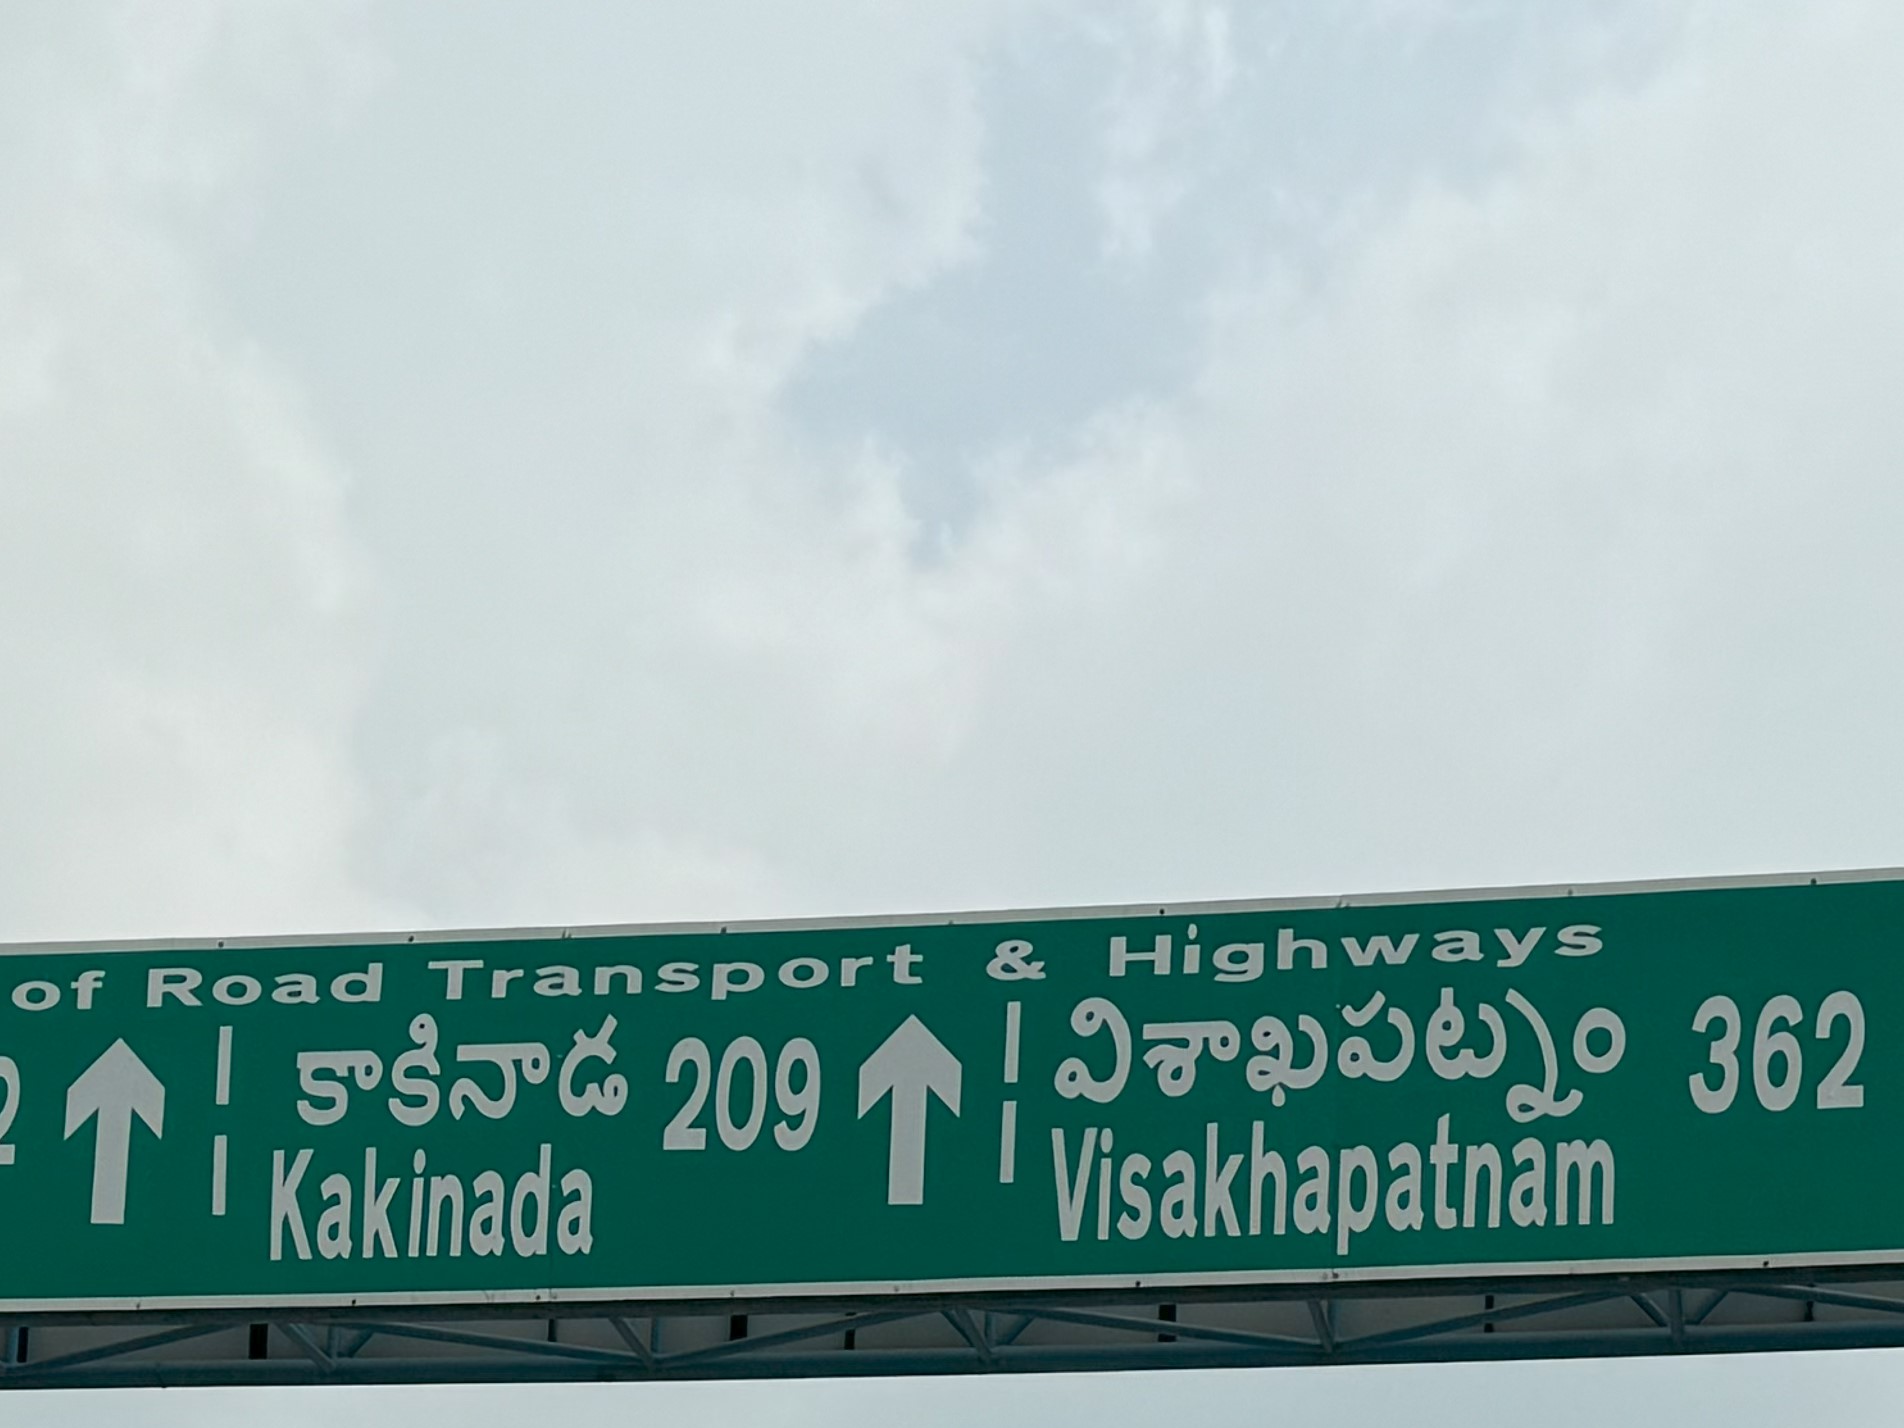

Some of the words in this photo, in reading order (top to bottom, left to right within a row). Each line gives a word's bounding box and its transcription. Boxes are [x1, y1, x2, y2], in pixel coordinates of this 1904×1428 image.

[12, 971, 105, 1010] of
[147, 963, 382, 1007] Road
[428, 944, 923, 1000] Transport
[987, 940, 1045, 980] &
[1110, 924, 1602, 982] Highways
[297, 1014, 628, 1126] కాకినాడ
[663, 1036, 820, 1151] 209
[1055, 988, 1625, 1122] విశాఖపట్నం
[1689, 991, 1865, 1113] 362
[270, 1144, 593, 1260] Kakinada
[1052, 1114, 1614, 1255] Visakhapatnam
